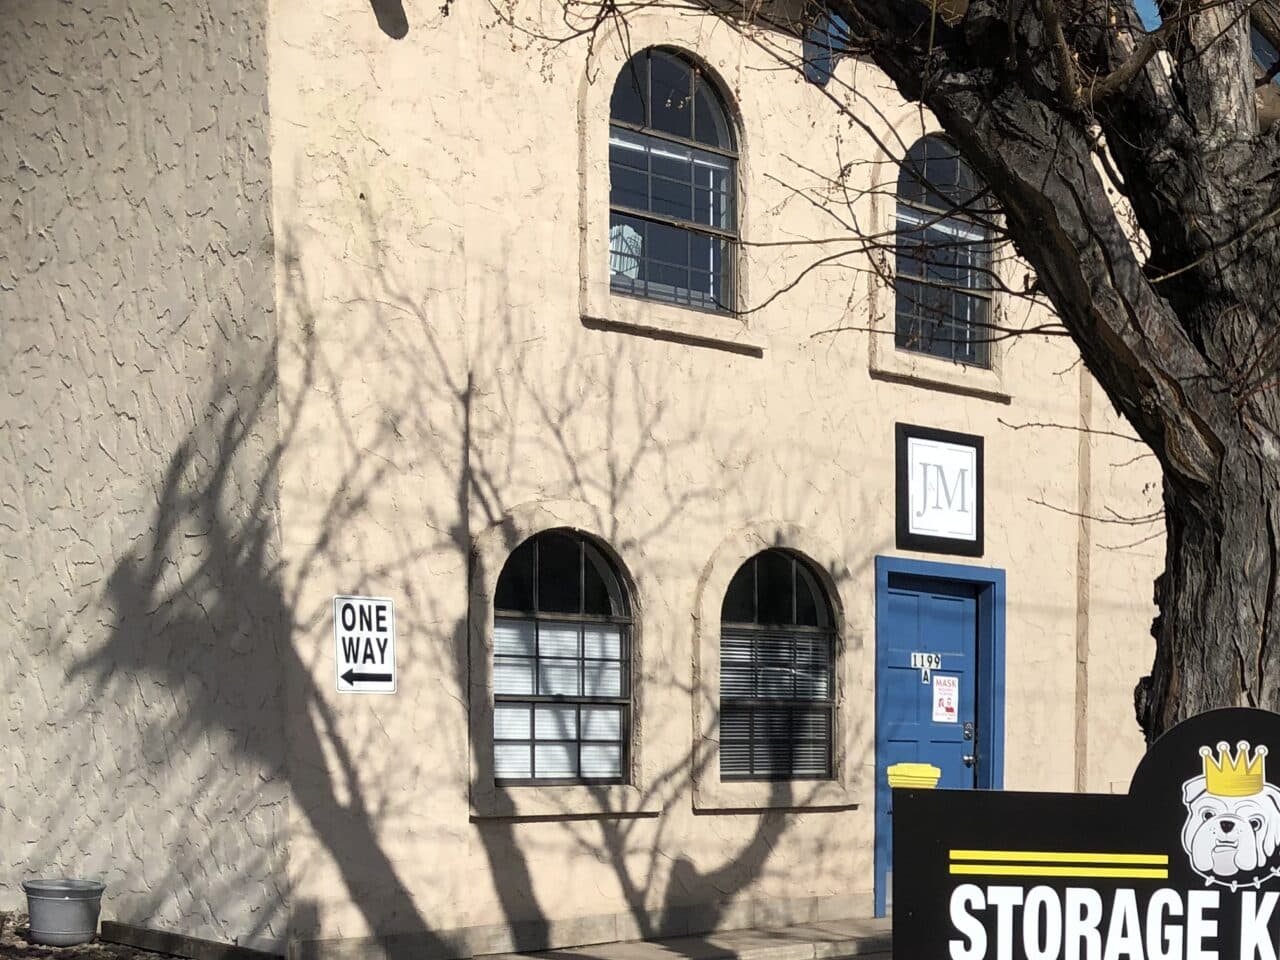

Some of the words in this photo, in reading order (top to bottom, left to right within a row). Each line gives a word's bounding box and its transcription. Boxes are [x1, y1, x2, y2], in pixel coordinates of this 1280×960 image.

[341, 603, 388, 632] ONE
[341, 636, 388, 664] WAY
[913, 654, 940, 668] 1199
[923, 670, 929, 682] A
[936, 679, 957, 688] MASK
